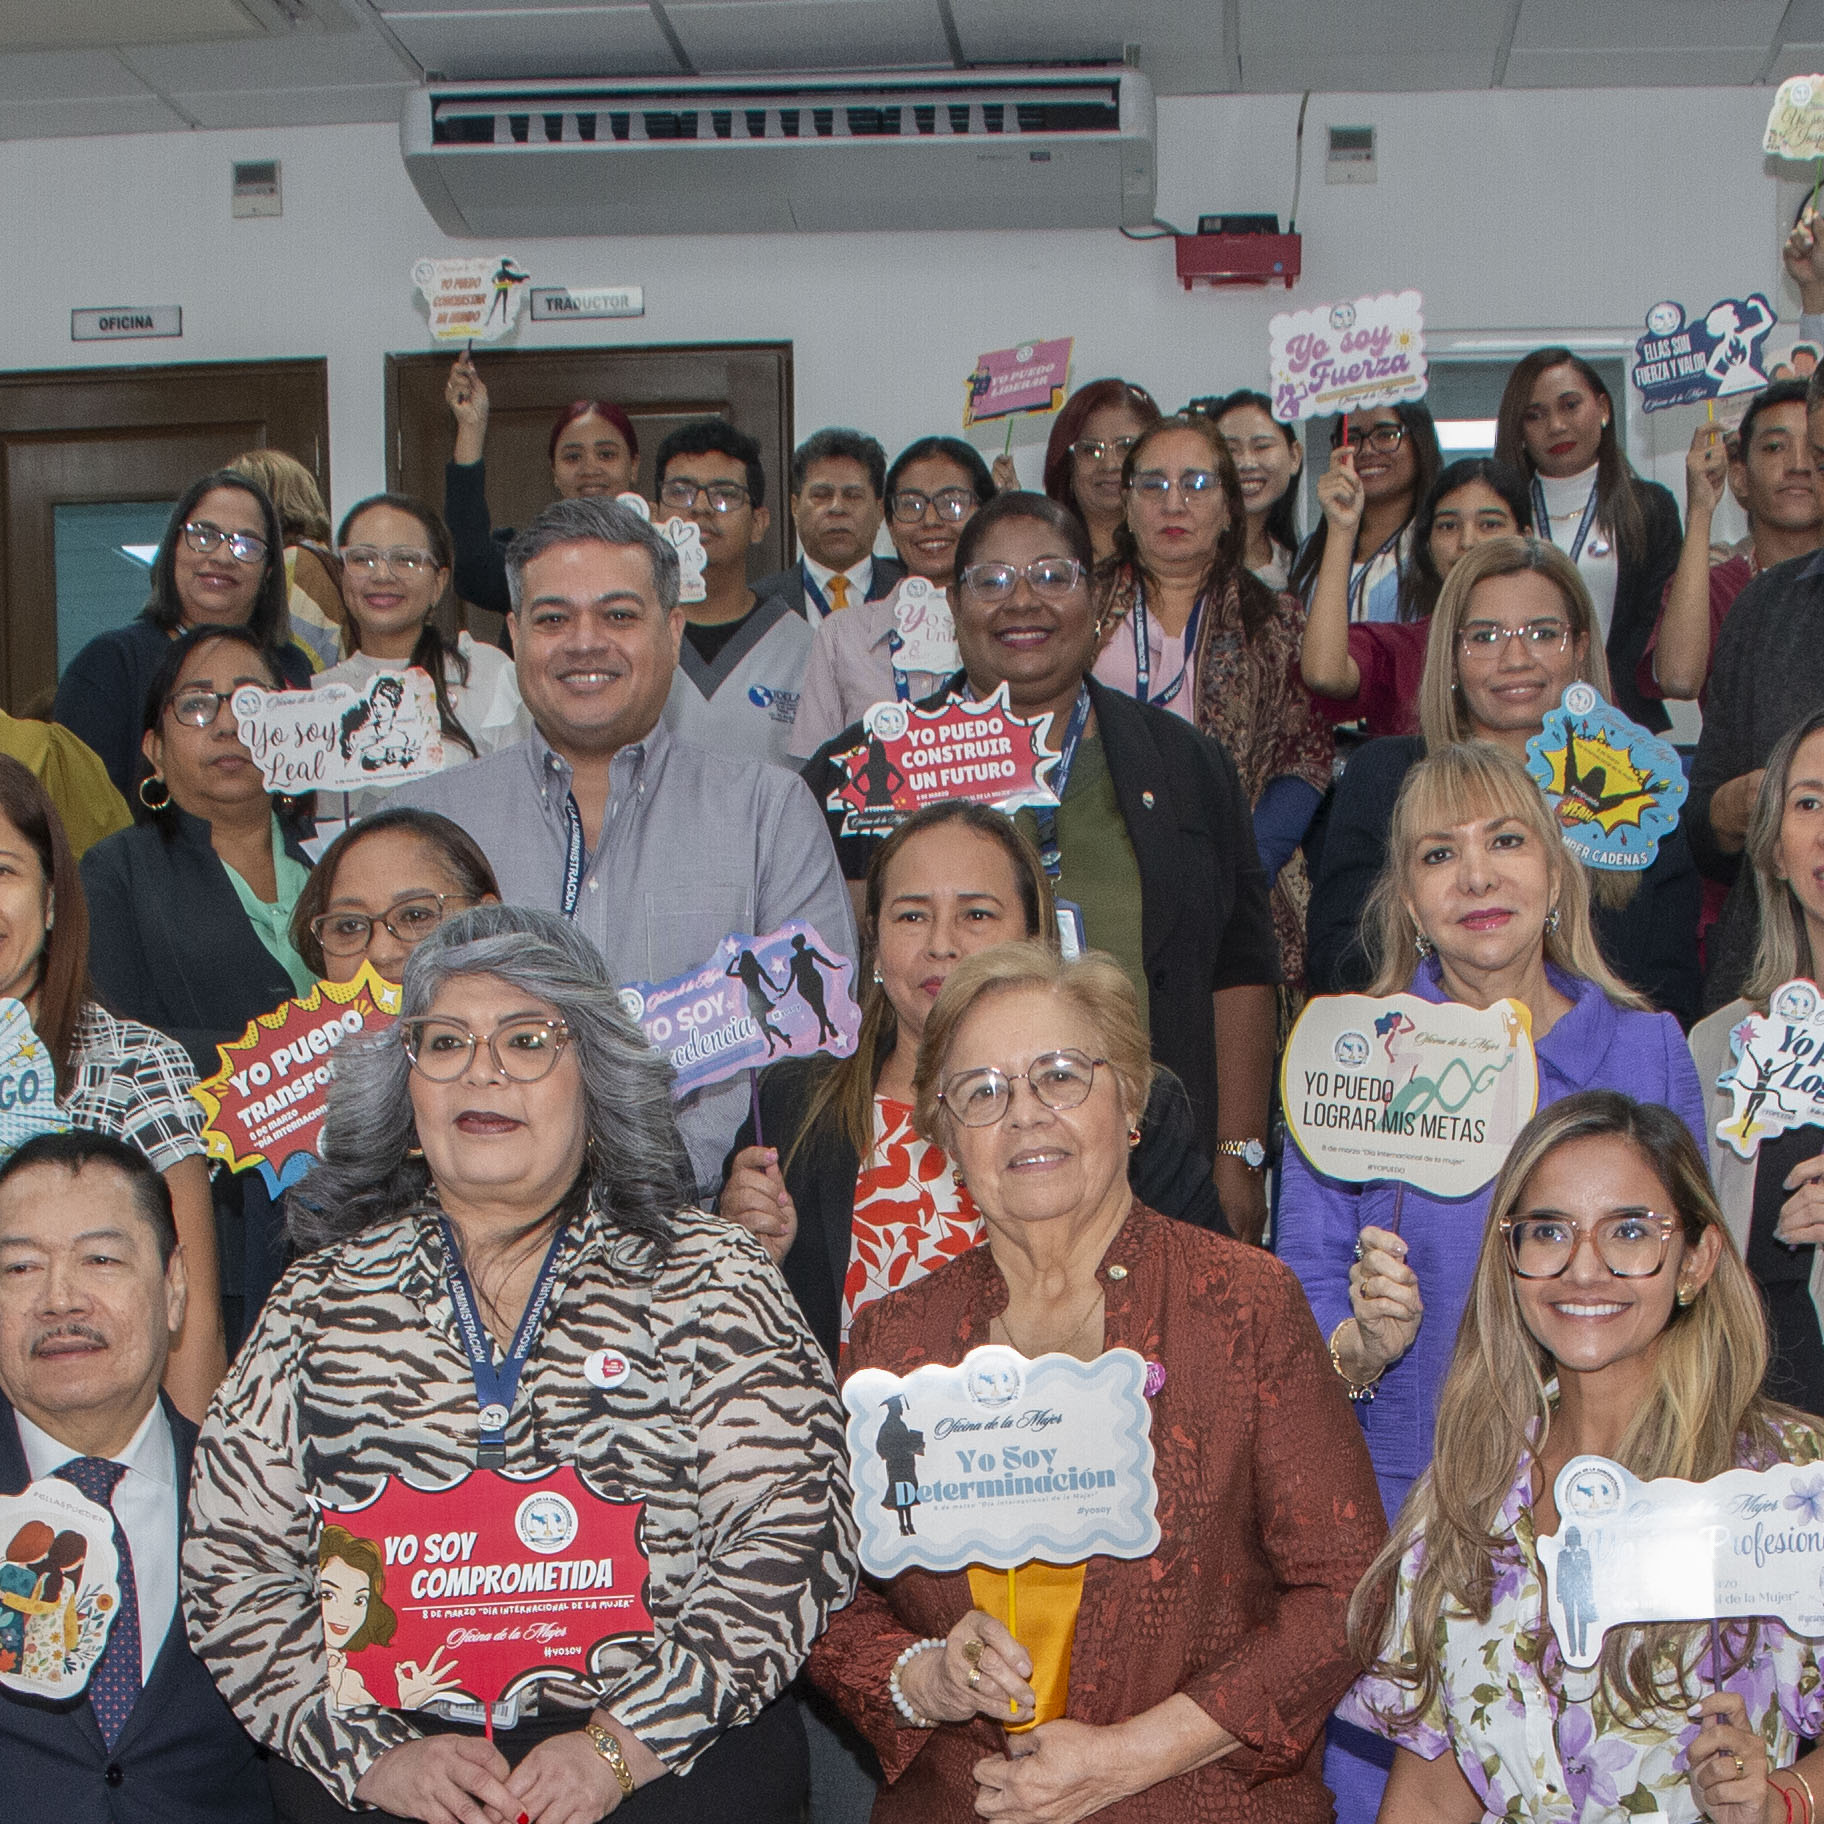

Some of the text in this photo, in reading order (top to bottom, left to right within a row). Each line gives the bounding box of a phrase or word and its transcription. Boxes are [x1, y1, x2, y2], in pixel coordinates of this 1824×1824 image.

[545, 296, 629, 311] TRADUCTOR
[99, 316, 153, 330] OFICINA
[1286, 325, 1392, 372] Yo soy
[1644, 334, 1691, 362] ELLAS SON
[1010, 364, 1055, 380] PUEDO
[1309, 353, 1410, 393] Fuerza
[1635, 363, 1668, 386] FUERZA
[1677, 352, 1707, 375] VALOR
[991, 376, 1048, 397] LIDERAR
[241, 720, 337, 759] Yo soy
[907, 718, 1003, 747] YO PUEDO
[901, 737, 1011, 768] CONSTRUIR
[265, 750, 326, 787] Leal
[909, 760, 1016, 791] UN FUTURO
[1592, 849, 1647, 866] CADENAS
[677, 992, 727, 1031] SOY
[671, 1016, 754, 1069] celencia
[1778, 1025, 1814, 1056] Yo
[229, 1062, 271, 1098] YO
[1304, 1070, 1394, 1104] YO PUEDO
[1303, 1101, 1486, 1144] LOGRAR MIS METAS
[451, 1280, 486, 1363] ADMINISTRACIÓN
[514, 1277, 555, 1360] PROCURADURÍA
[933, 1408, 1063, 1440] Oficina de la Mujer
[955, 1445, 1058, 1474] Yo Soy
[894, 1466, 1116, 1507] Determinación
[1077, 1505, 1112, 1515] #yosoy
[1726, 1493, 1780, 1520] Mujer
[384, 1532, 478, 1566] YO SOY
[410, 1558, 613, 1600] COMPROMETIDA
[430, 1609, 442, 1618] DE
[444, 1608, 477, 1619] MARZO
[499, 1602, 569, 1616] INTERNACIONAL
[571, 1602, 583, 1610] DE
[1725, 1593, 1741, 1605] de
[1744, 1592, 1756, 1604] la
[446, 1621, 568, 1650] Oficina de la Mujer
